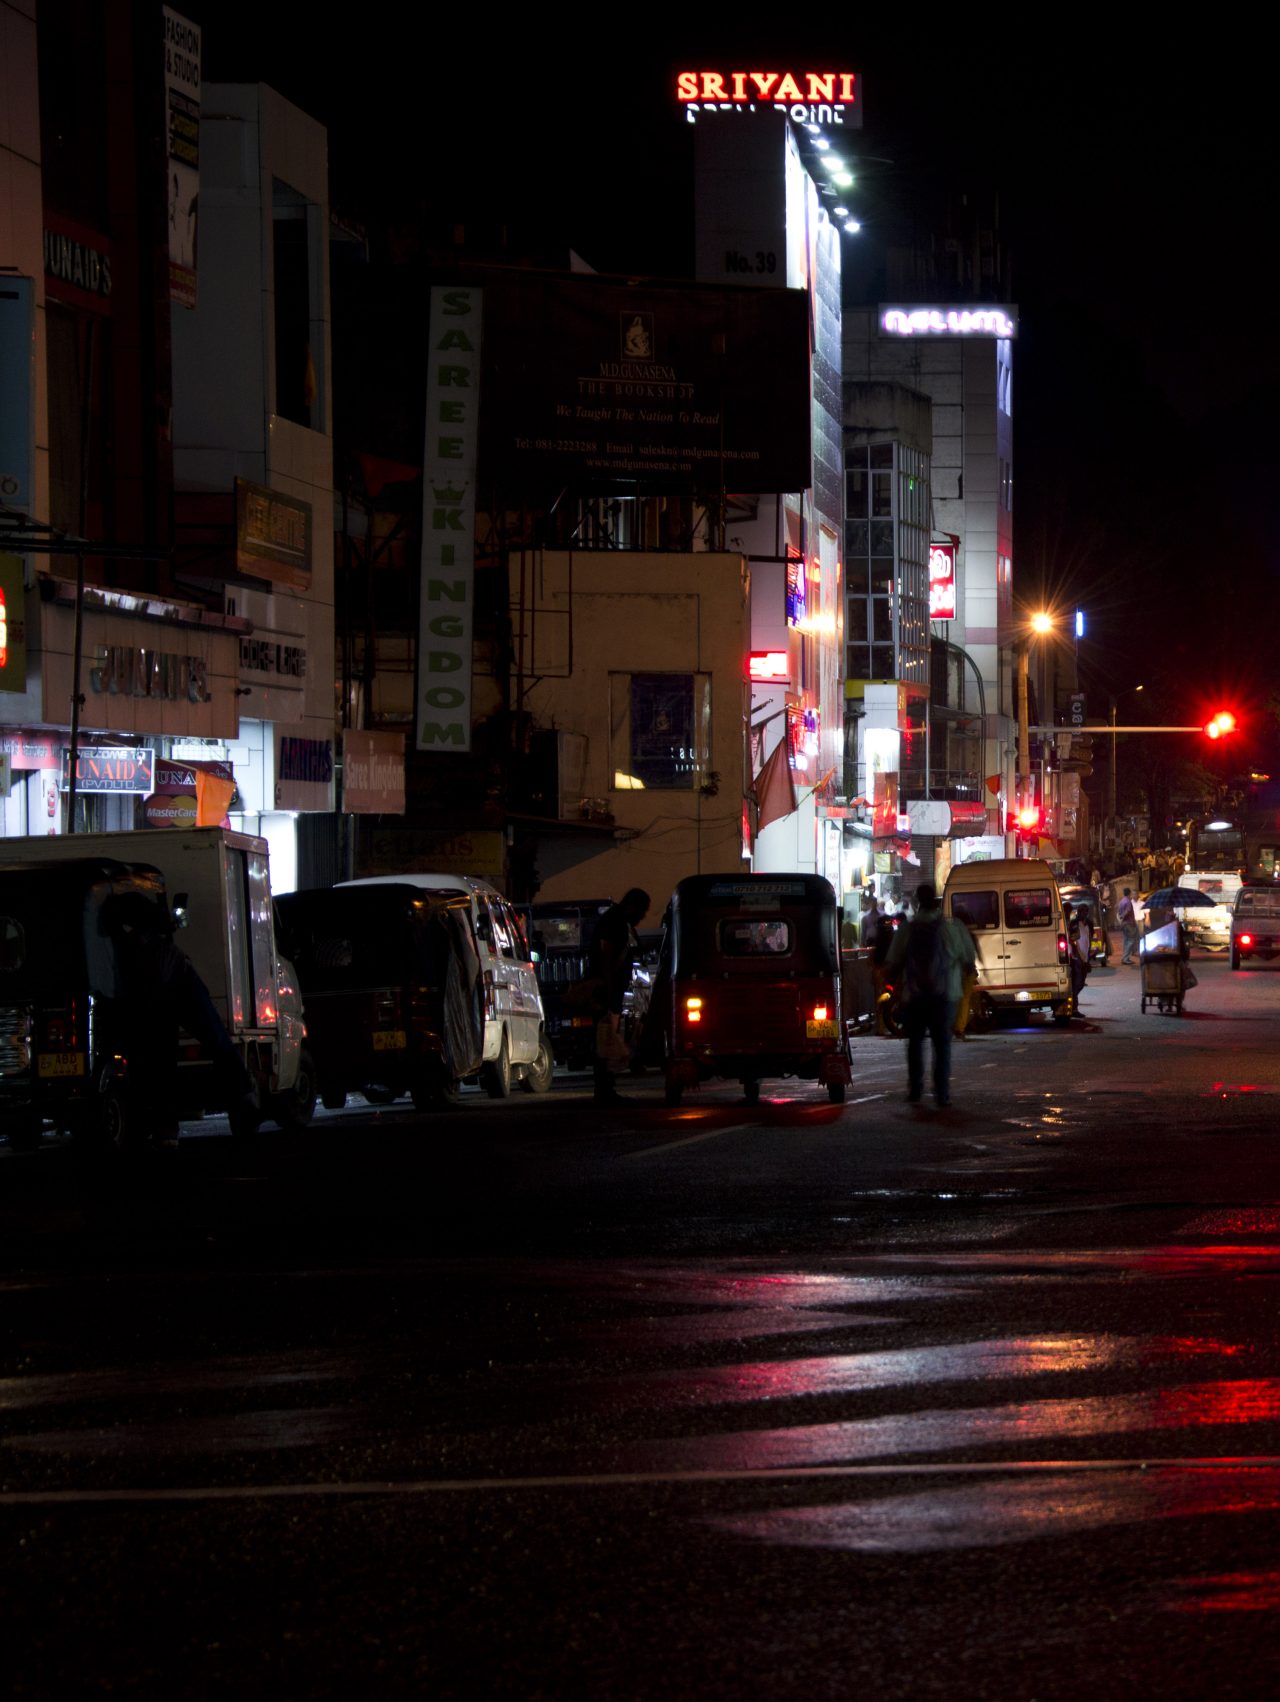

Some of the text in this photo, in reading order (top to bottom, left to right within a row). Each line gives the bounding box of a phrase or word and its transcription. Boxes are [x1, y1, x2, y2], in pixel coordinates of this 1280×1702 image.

[678, 73, 855, 101] SRIYANI
[578, 381, 695, 399] THE BOOKSHOP
[556, 404, 719, 425] We Taught The Nation To Read
[422, 290, 474, 746] SAREE KINGDOM
